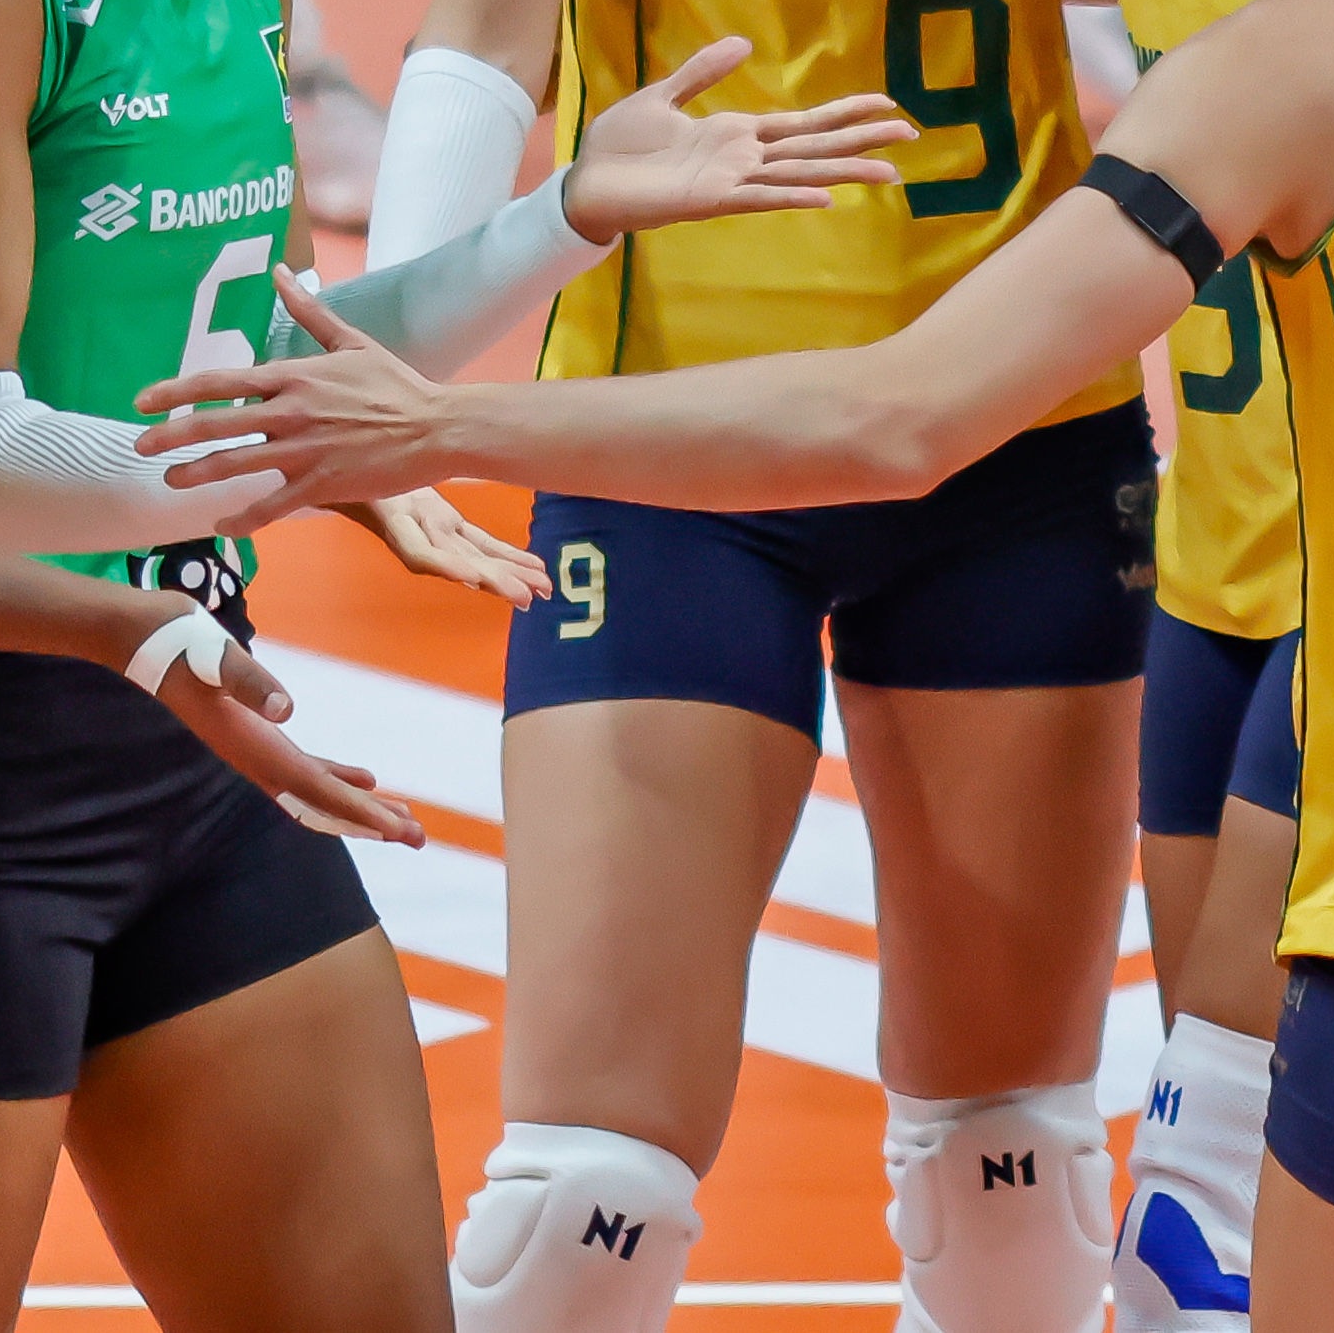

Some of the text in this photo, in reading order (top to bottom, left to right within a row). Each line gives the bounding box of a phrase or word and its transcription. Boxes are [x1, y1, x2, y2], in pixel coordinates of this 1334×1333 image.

[100, 92, 169, 126] VOLT
[149, 183, 243, 232] BANCO
[245, 176, 275, 216] DO
[168, 233, 274, 421] 6
[559, 542, 605, 640] 9
[1147, 1078, 1183, 1127] N1
[981, 1150, 1038, 1191] N1
[581, 1203, 647, 1262] N1
